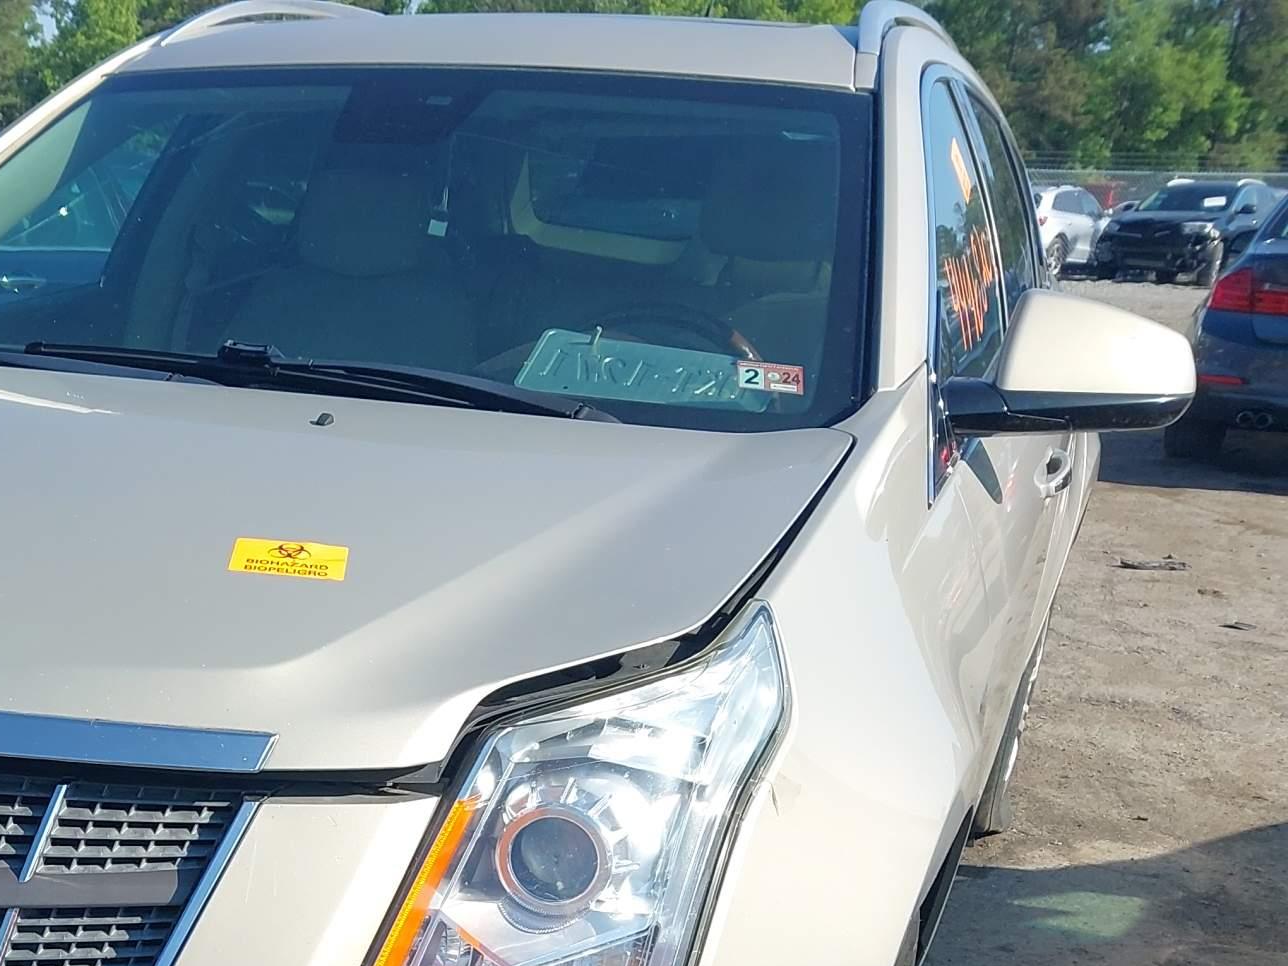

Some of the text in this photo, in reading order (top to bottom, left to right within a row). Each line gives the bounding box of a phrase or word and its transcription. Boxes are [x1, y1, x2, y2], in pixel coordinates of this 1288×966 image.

[744, 368, 760, 385] 2
[782, 372, 801, 385] 24
[246, 558, 329, 570] BIOHAZARD
[244, 565, 328, 577] BIOPELIGRO
